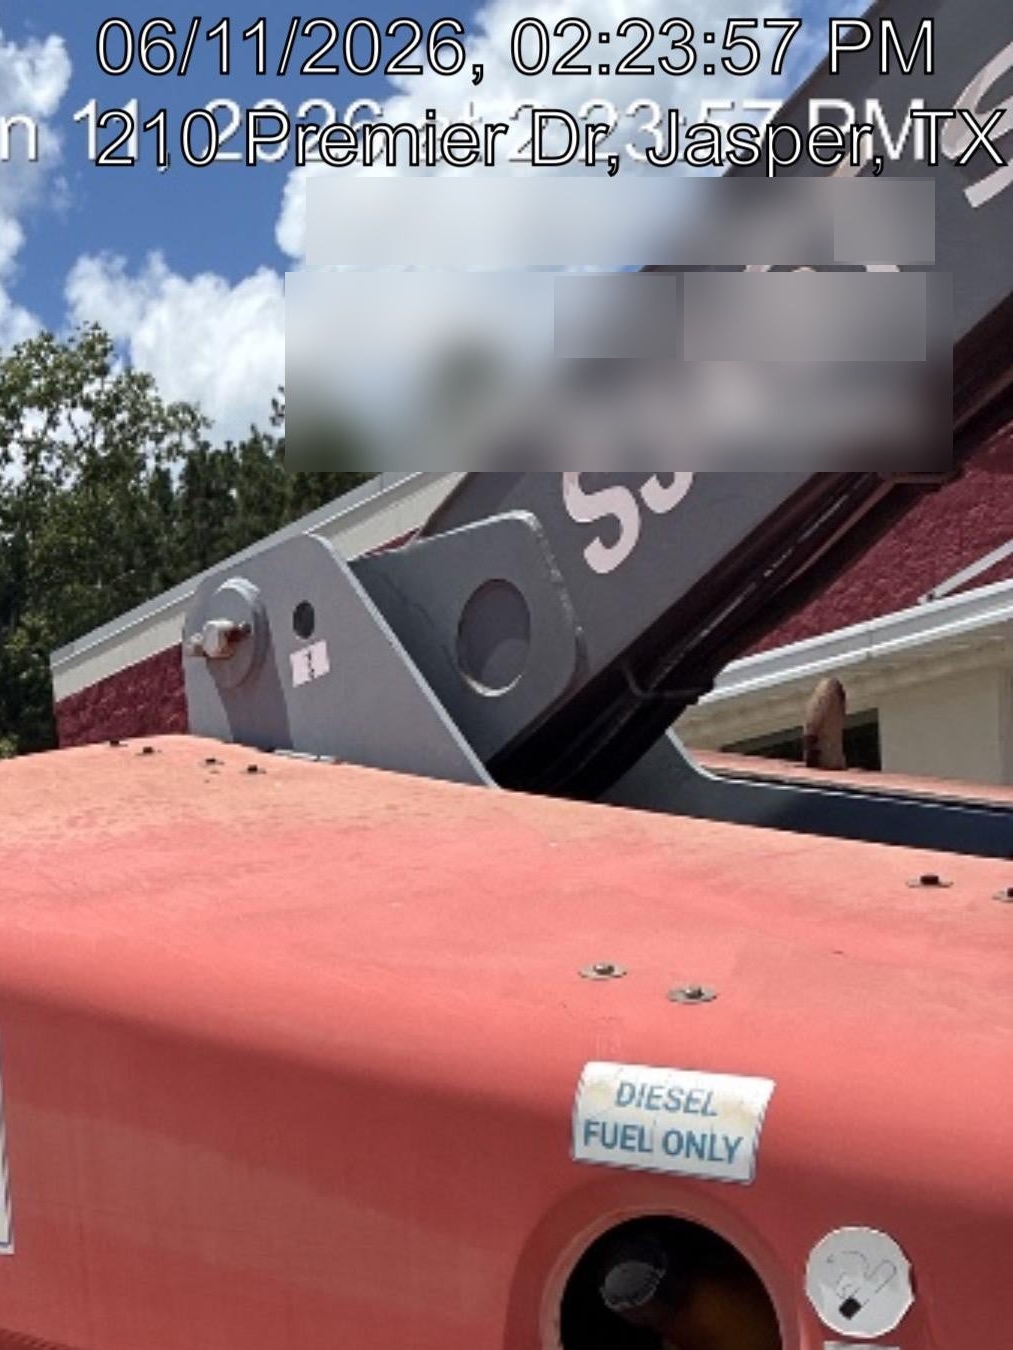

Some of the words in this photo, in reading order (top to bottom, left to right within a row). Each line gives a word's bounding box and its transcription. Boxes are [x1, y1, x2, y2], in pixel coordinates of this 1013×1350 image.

[615, 1081, 717, 1117] DIESEL
[583, 1119, 653, 1153] FUEL
[662, 1129, 744, 1164] ONLY
